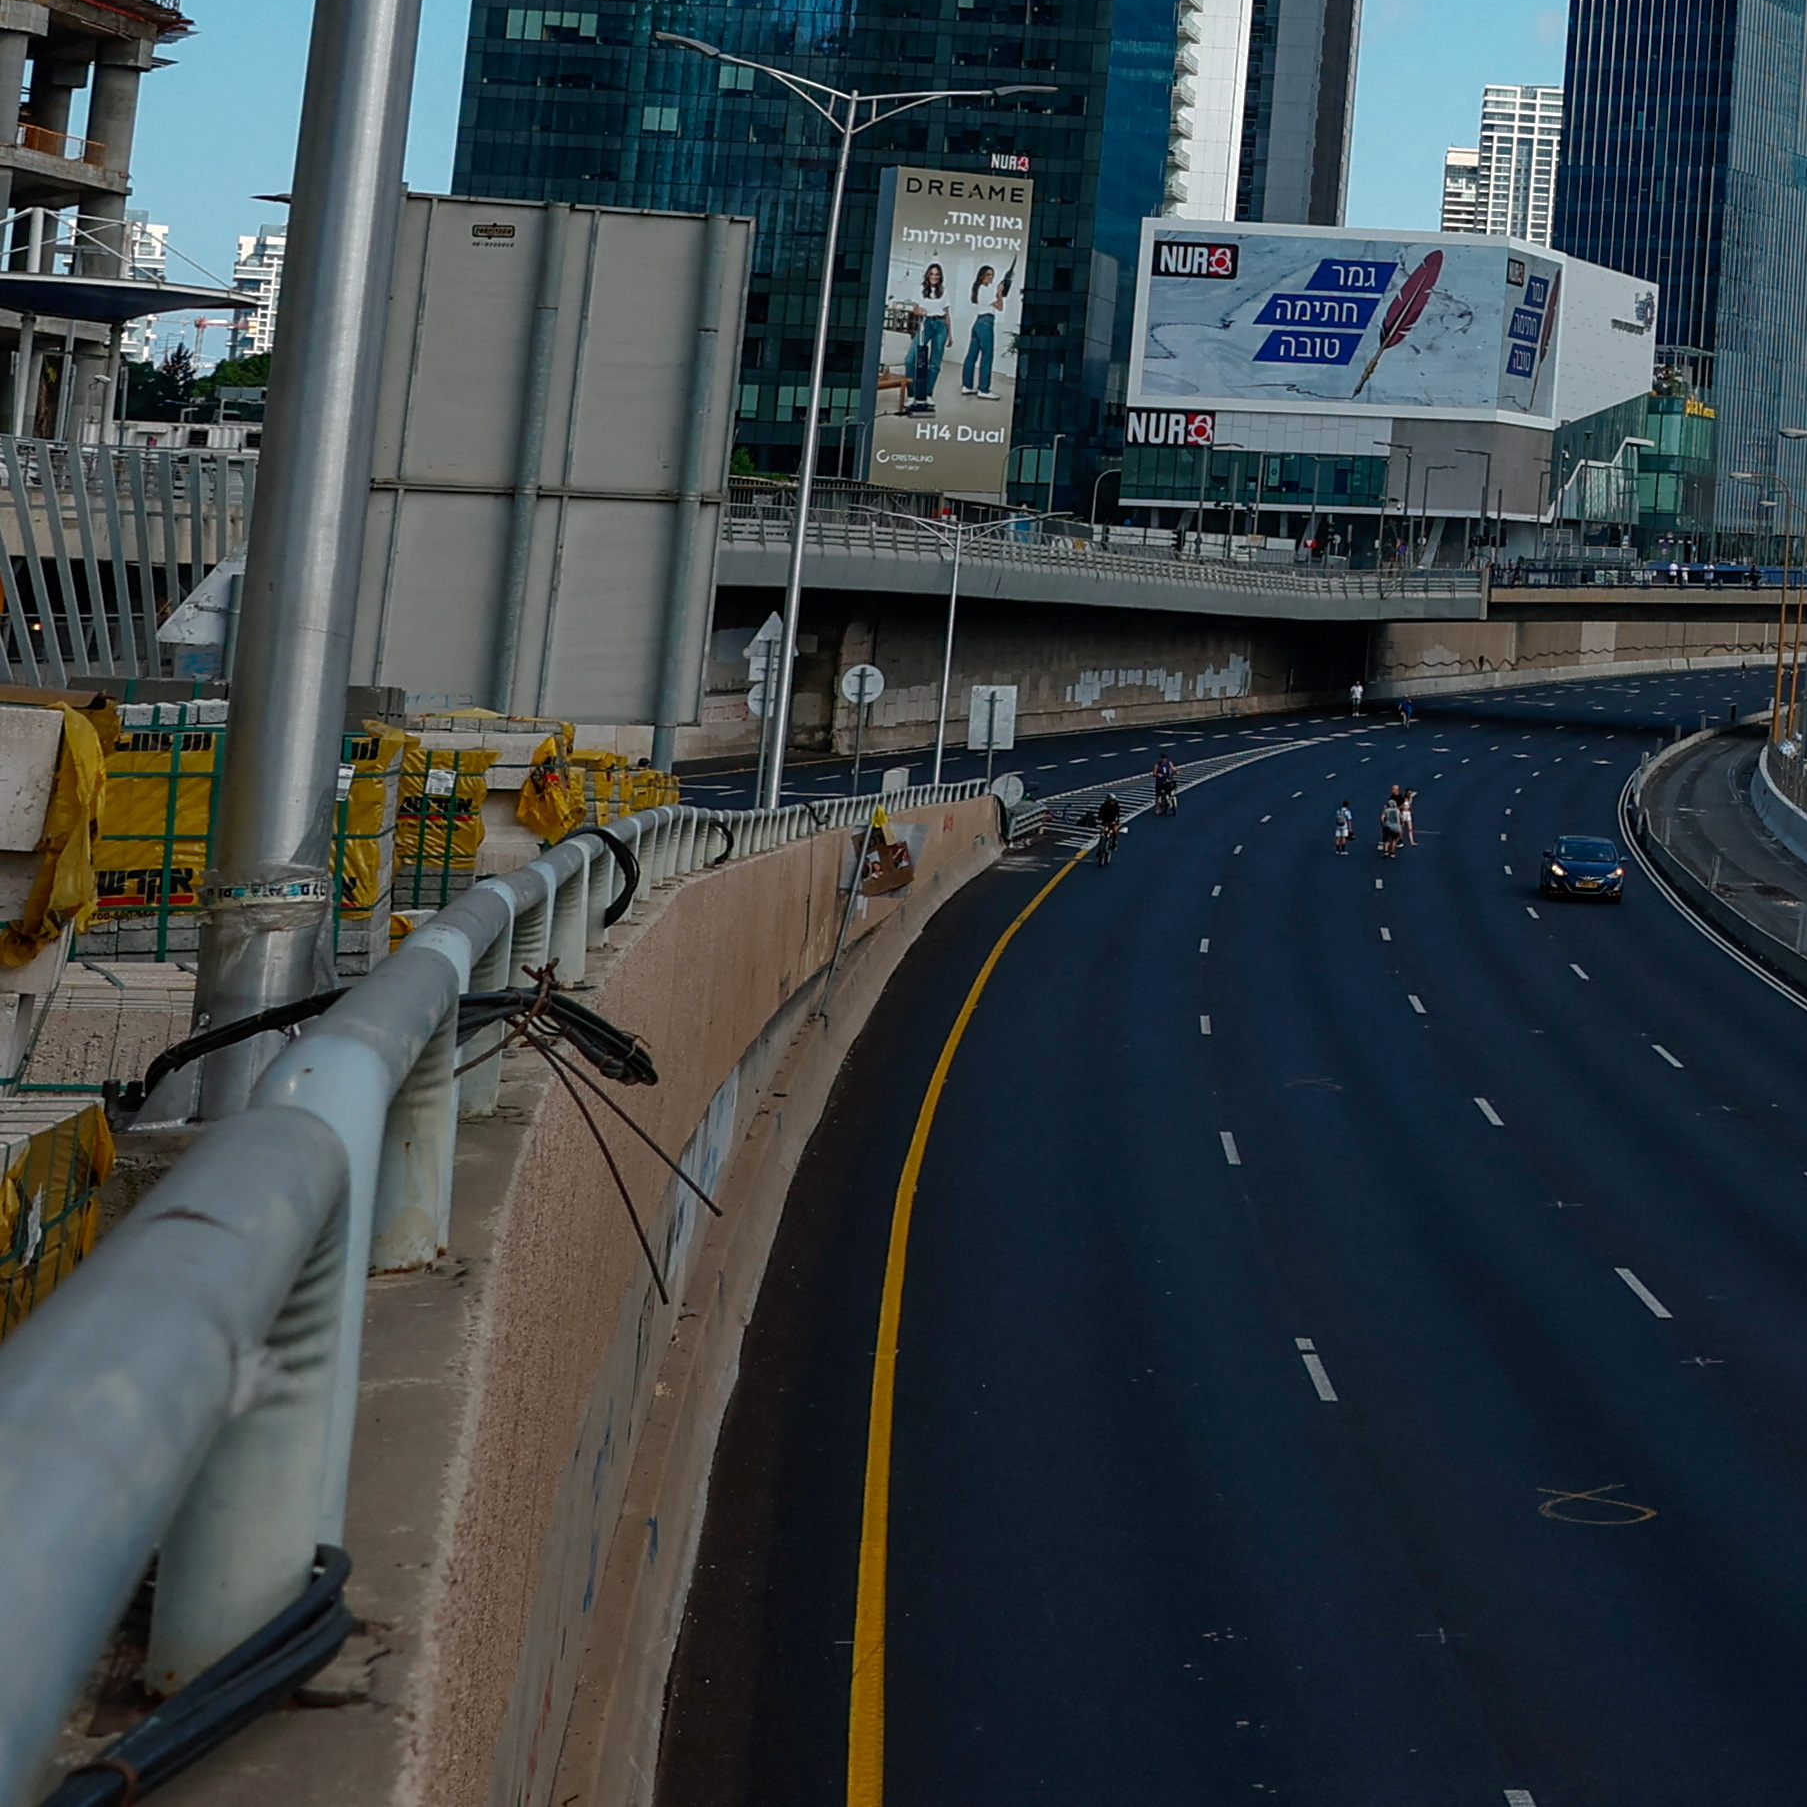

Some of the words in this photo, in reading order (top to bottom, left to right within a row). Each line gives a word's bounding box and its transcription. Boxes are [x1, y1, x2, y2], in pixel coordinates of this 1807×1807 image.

[906, 177, 1025, 203] DREAME
[944, 211, 985, 227] אחד,
[989, 215, 1022, 231] גאון
[902, 227, 960, 245] יכולות!
[964, 234, 1021, 251] אינסוף
[1333, 265, 1376, 288] גמר
[1531, 281, 1544, 302] גמר
[1275, 298, 1359, 324] חתימה
[1514, 313, 1537, 337] חתימה
[1279, 335, 1340, 360] טובה
[1513, 349, 1531, 372] טובה
[916, 423, 951, 441] H14
[957, 424, 1005, 443] Dual
